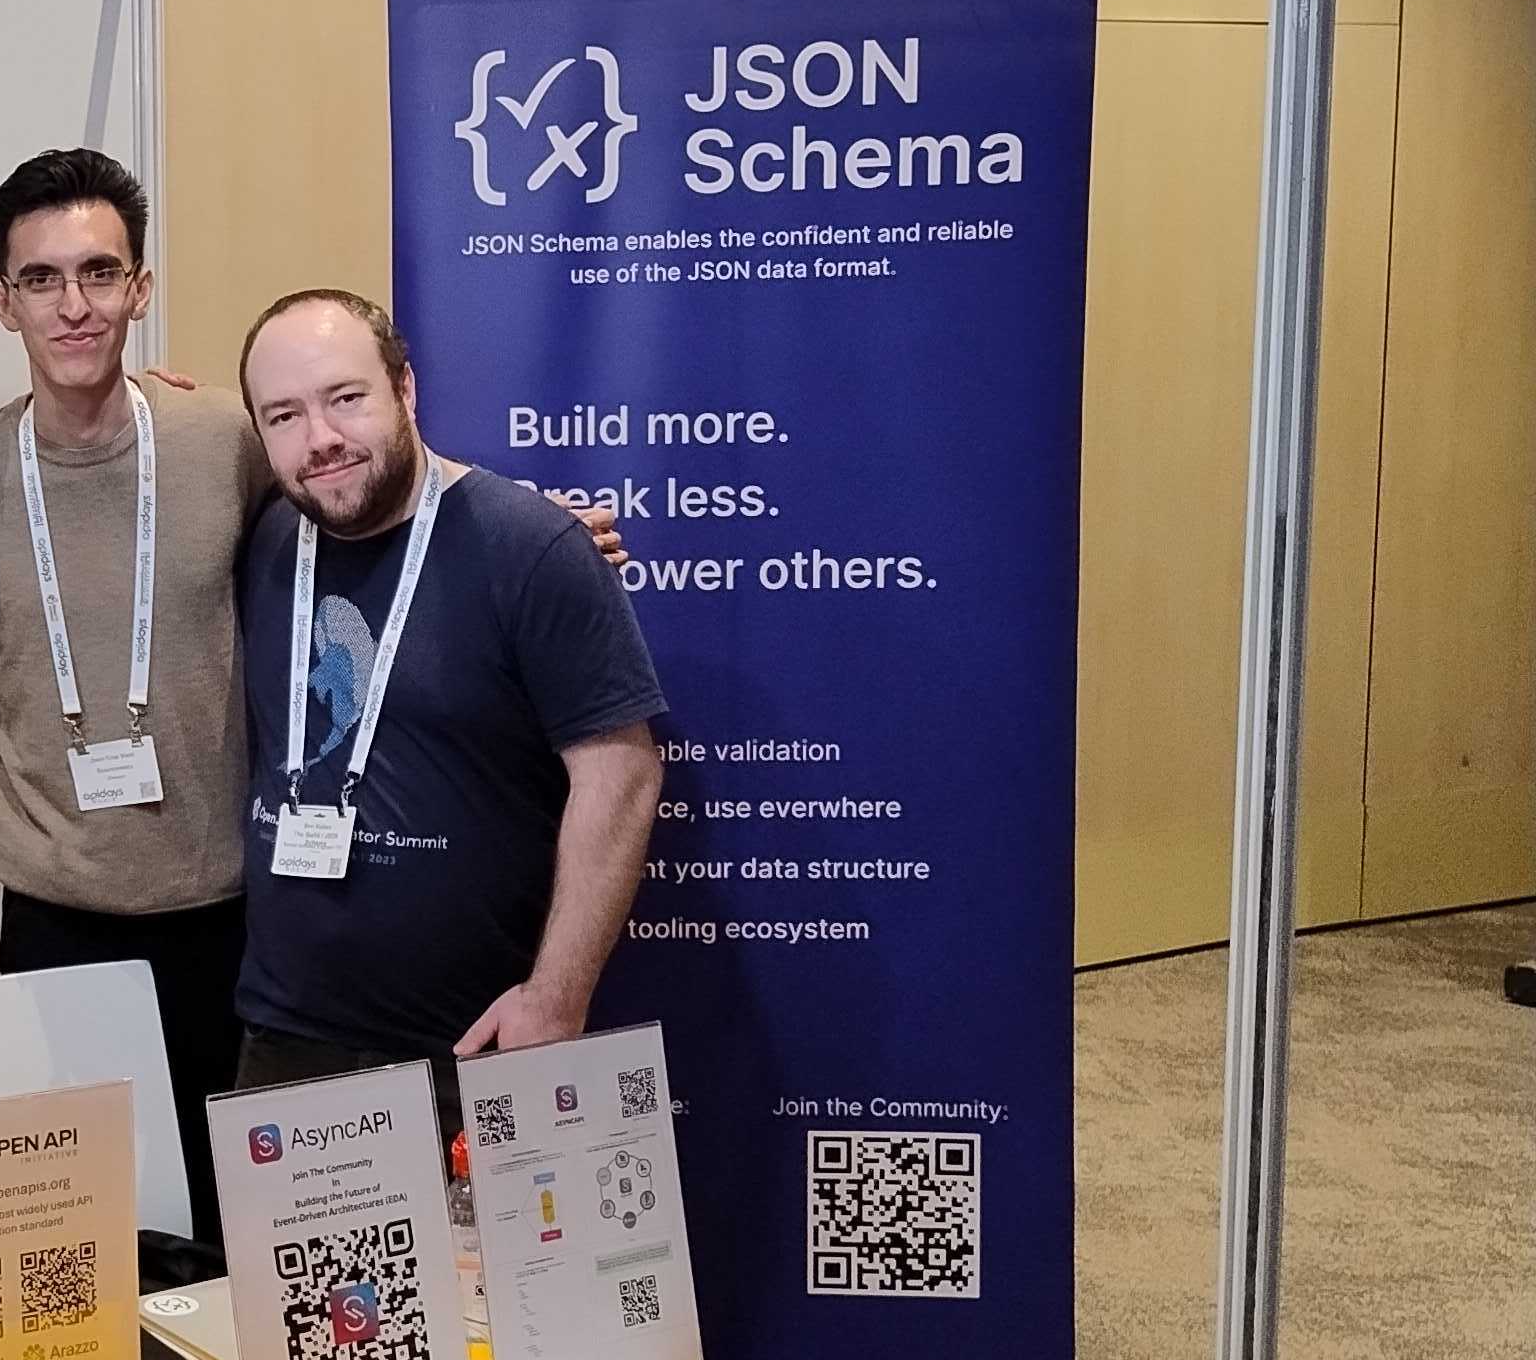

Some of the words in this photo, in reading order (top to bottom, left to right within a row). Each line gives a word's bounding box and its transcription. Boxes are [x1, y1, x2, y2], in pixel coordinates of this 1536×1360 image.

[684, 37, 920, 113] JSON
[683, 126, 1025, 196] Schema
[461, 233, 524, 256] JSON
[530, 232, 619, 254] Schema
[624, 229, 713, 251] enables
[719, 228, 756, 248] the
[762, 224, 871, 248] confident
[877, 222, 921, 243] and
[927, 219, 1014, 241] reliable
[570, 266, 610, 285] use
[615, 262, 640, 284] of
[645, 262, 681, 283] the
[687, 260, 751, 282] JSON
[757, 259, 808, 280] data
[814, 256, 897, 278] format.
[508, 404, 629, 448] Build
[647, 410, 790, 445] more.
[513, 477, 651, 520] eak
[667, 476, 780, 518] less.
[623, 556, 744, 593] ower
[759, 548, 938, 590] others.
[714, 738, 841, 762] validation
[704, 800, 752, 819] use
[759, 796, 903, 819] everwhere
[385, 830, 449, 850] Summit
[368, 853, 396, 866] 2023
[674, 861, 733, 884] your
[740, 857, 800, 880] data
[807, 858, 931, 880] structure
[628, 916, 717, 945] tooling
[725, 918, 870, 945] ecosystem
[772, 1097, 819, 1117] Join
[827, 1097, 863, 1117] the
[869, 1097, 1010, 1124] Community:
[43, 1127, 78, 1151] API
[291, 1109, 393, 1151] AsyncAPI
[292, 1168, 309, 1183] Join
[309, 1166, 325, 1177] The
[326, 1157, 374, 1174] Community
[16, 1202, 48, 1217] widely
[50, 1197, 75, 1211] used
[76, 1194, 94, 1207] API
[272, 1209, 328, 1228] Event-Driven
[328, 1197, 384, 1218] Architectures
[385, 1191, 408, 1206] (EDA)
[294, 1192, 329, 1209] Building
[329, 1191, 343, 1202] the
[344, 1185, 371, 1200] Future
[372, 1183, 381, 1193] of
[18, 1215, 65, 1232] standard
[49, 1339, 100, 1360] Arazzo
